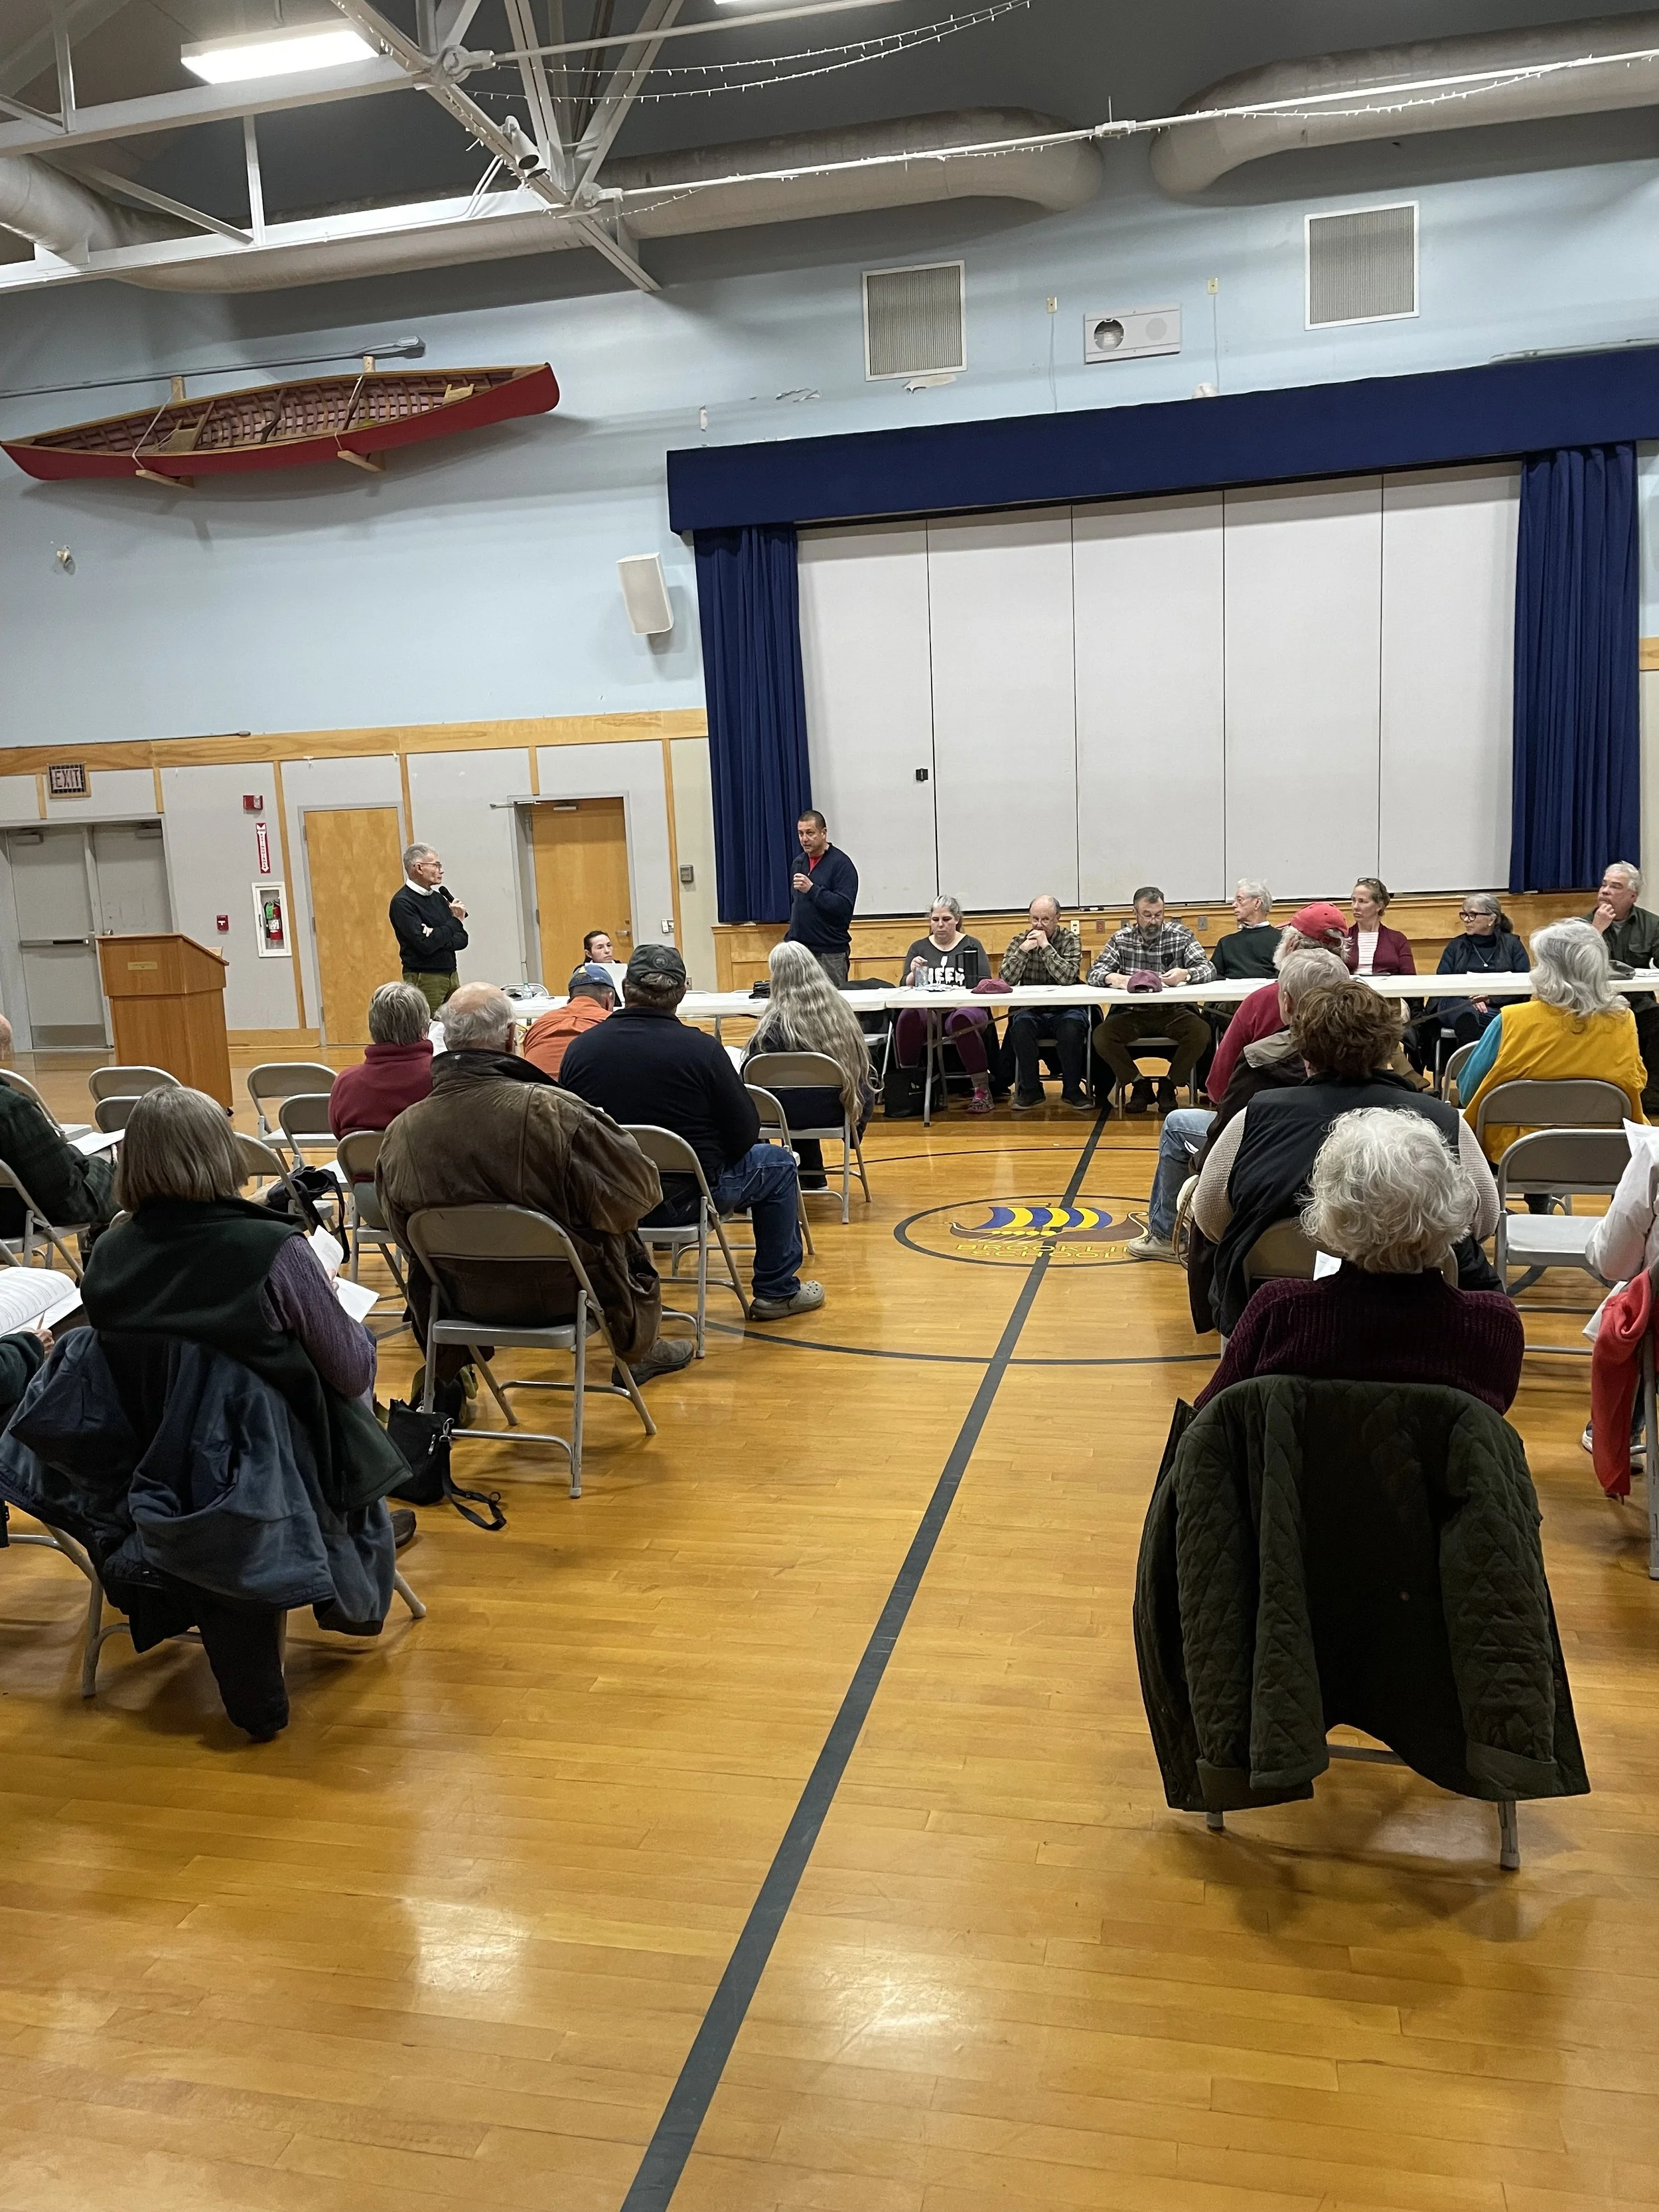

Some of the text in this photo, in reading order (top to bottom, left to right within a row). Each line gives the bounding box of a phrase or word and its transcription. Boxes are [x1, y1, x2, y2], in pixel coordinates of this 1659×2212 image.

[55, 770, 79, 788] EXIT
[956, 1244, 1128, 1252] BROOKLI
[970, 1250, 1123, 1259] SCHOOL
